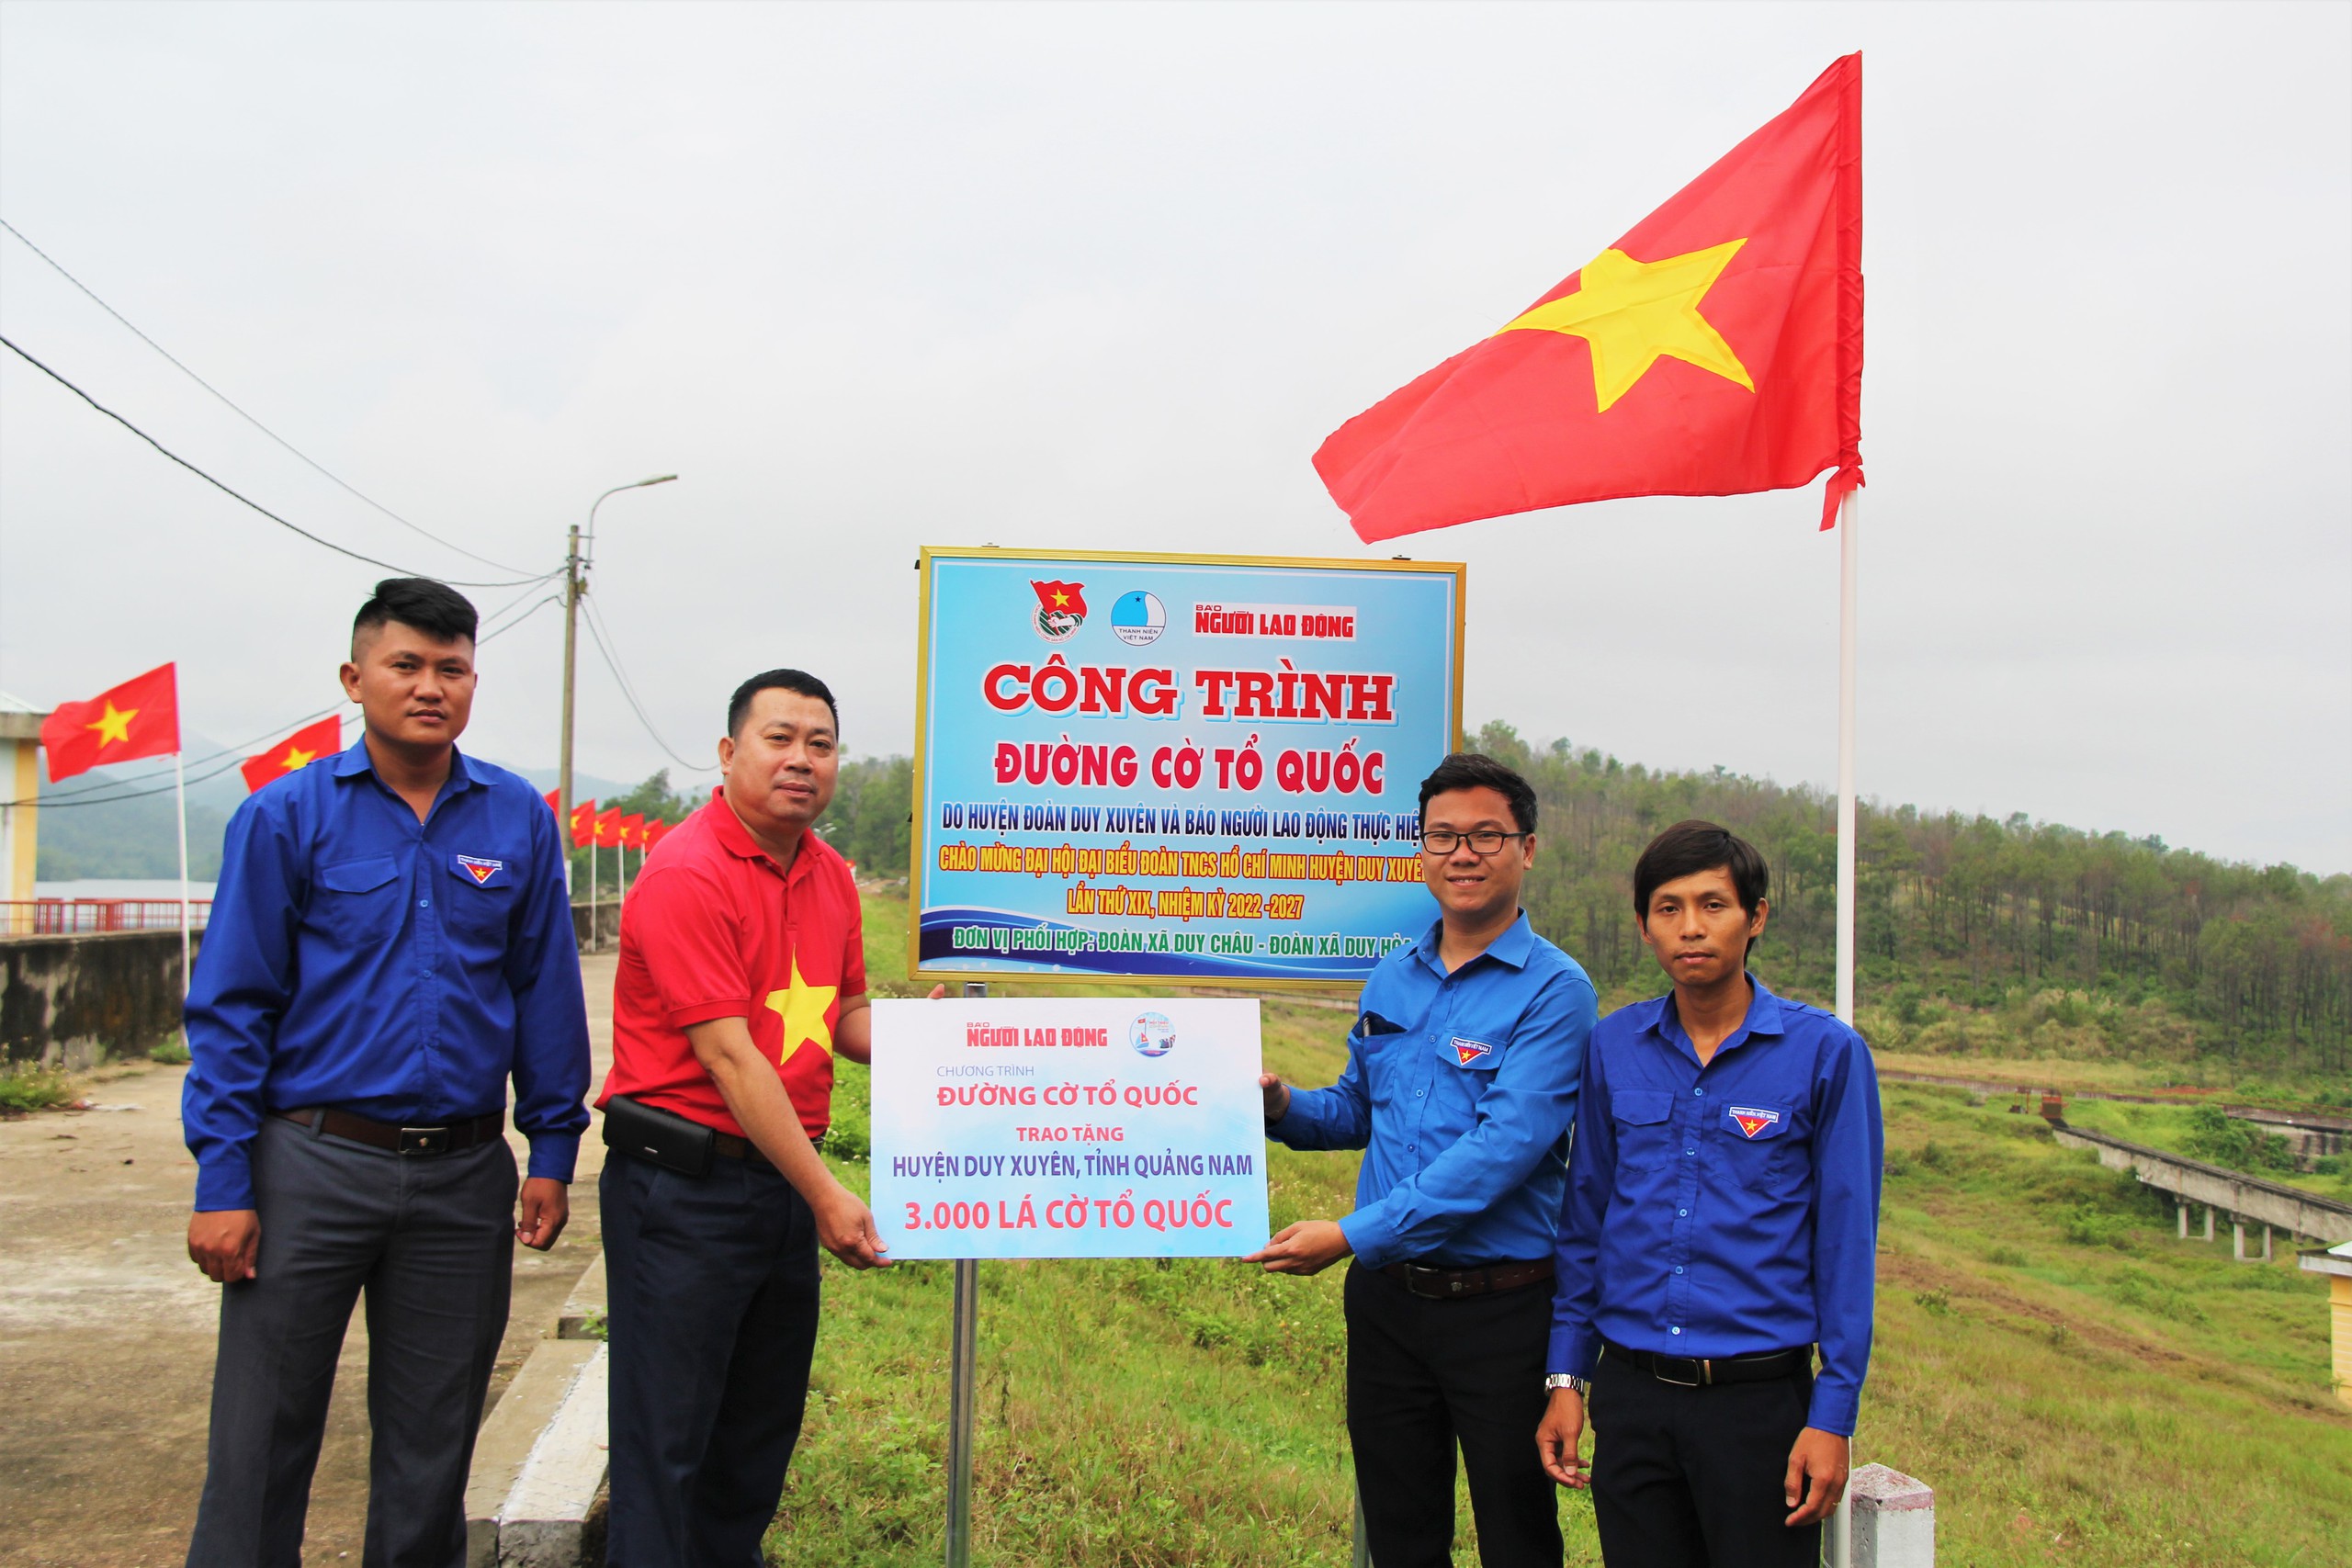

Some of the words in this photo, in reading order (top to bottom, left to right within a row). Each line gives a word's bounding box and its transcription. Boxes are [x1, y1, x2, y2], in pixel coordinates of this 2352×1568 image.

[1195, 610, 1254, 635] NGƯỜI
[1260, 614, 1296, 636] LAO
[1301, 613, 1353, 638] ĐỘNG
[984, 653, 1178, 716] CÔNG
[1195, 659, 1393, 721] TRÌNH
[995, 734, 1138, 788] ĐƯỜNG
[1151, 738, 1204, 789] CỜ
[1215, 733, 1263, 791] TỔ
[1276, 738, 1384, 795] QUỐC
[943, 803, 963, 829] DO
[968, 799, 1019, 836] HUYỆN
[1023, 800, 1067, 832] ĐOÀN
[1070, 806, 1102, 833] DUY
[1105, 803, 1157, 834] XUYÊN
[1161, 804, 1181, 835] VÀ
[1185, 804, 1216, 836] BÁO
[1220, 805, 1268, 838] NGƯỜI
[1272, 811, 1300, 838] LAO
[1306, 807, 1348, 844] ĐỘNG
[1352, 811, 1391, 846] THỰC
[1396, 810, 1420, 847] HIỆ
[939, 840, 978, 871] CHÀO
[979, 841, 1023, 873] MỪNG
[1023, 846, 1049, 878] ĐẠI
[1051, 843, 1077, 878] HỘI
[1078, 848, 1103, 878] ĐẠI
[1104, 840, 1138, 875] BIỂU
[1139, 846, 1179, 876] ĐOÀN
[1181, 852, 1218, 878] TNCS
[1219, 845, 1241, 879] HỒ
[1242, 848, 1268, 879] CHÍ
[1269, 852, 1306, 880] MINH
[1308, 851, 1355, 886] HUYỆN
[1356, 855, 1385, 882] DUY
[1067, 880, 1095, 914] LẦN
[1097, 885, 1126, 915] THỨ
[1126, 889, 1156, 919] XIX,
[1158, 886, 1204, 922] NHIỆM
[1206, 887, 1226, 918] KỲ
[1227, 893, 1263, 919] 2022
[954, 926, 989, 949] ĐƠN
[993, 928, 1009, 953] VỊ
[1012, 923, 1052, 950] PHỐI
[1056, 929, 1094, 954] HỢP:
[1098, 929, 1143, 952] ĐOÀN
[1148, 930, 1170, 953] XÃ
[1174, 933, 1205, 953] DUY
[1210, 931, 1254, 954] CHÂU
[1269, 932, 1314, 955] ĐOÀN
[1318, 932, 1342, 956] XÃ
[1345, 937, 1376, 957] DUY
[967, 1026, 1019, 1047] NGƯỜI
[1024, 1028, 1057, 1047] LAO
[1061, 1026, 1108, 1048] ĐỘNG
[936, 1064, 994, 1077] CHƯƠNG
[997, 1064, 1035, 1077] TRÌNH
[936, 1081, 1036, 1106] ĐƯỜNG
[1043, 1081, 1080, 1107] CỜ
[1083, 1078, 1117, 1106] TỔ
[1124, 1080, 1198, 1110] QUỐC
[1016, 1126, 1069, 1143] TRAO
[1072, 1123, 1125, 1146] TẶNG
[893, 1151, 959, 1184] HUYỆN
[965, 1155, 1006, 1177] DUY
[1011, 1150, 1080, 1180] XUYÊN,
[1084, 1147, 1130, 1177] TỈNH
[1134, 1147, 1204, 1180] QUẢNG
[1209, 1155, 1253, 1177] NAM
[904, 1201, 990, 1230] 3.000
[999, 1194, 1038, 1229] LÁ
[1046, 1193, 1090, 1229] CỜ
[1094, 1189, 1136, 1229] TỔ
[1143, 1190, 1233, 1233] QUỐC
